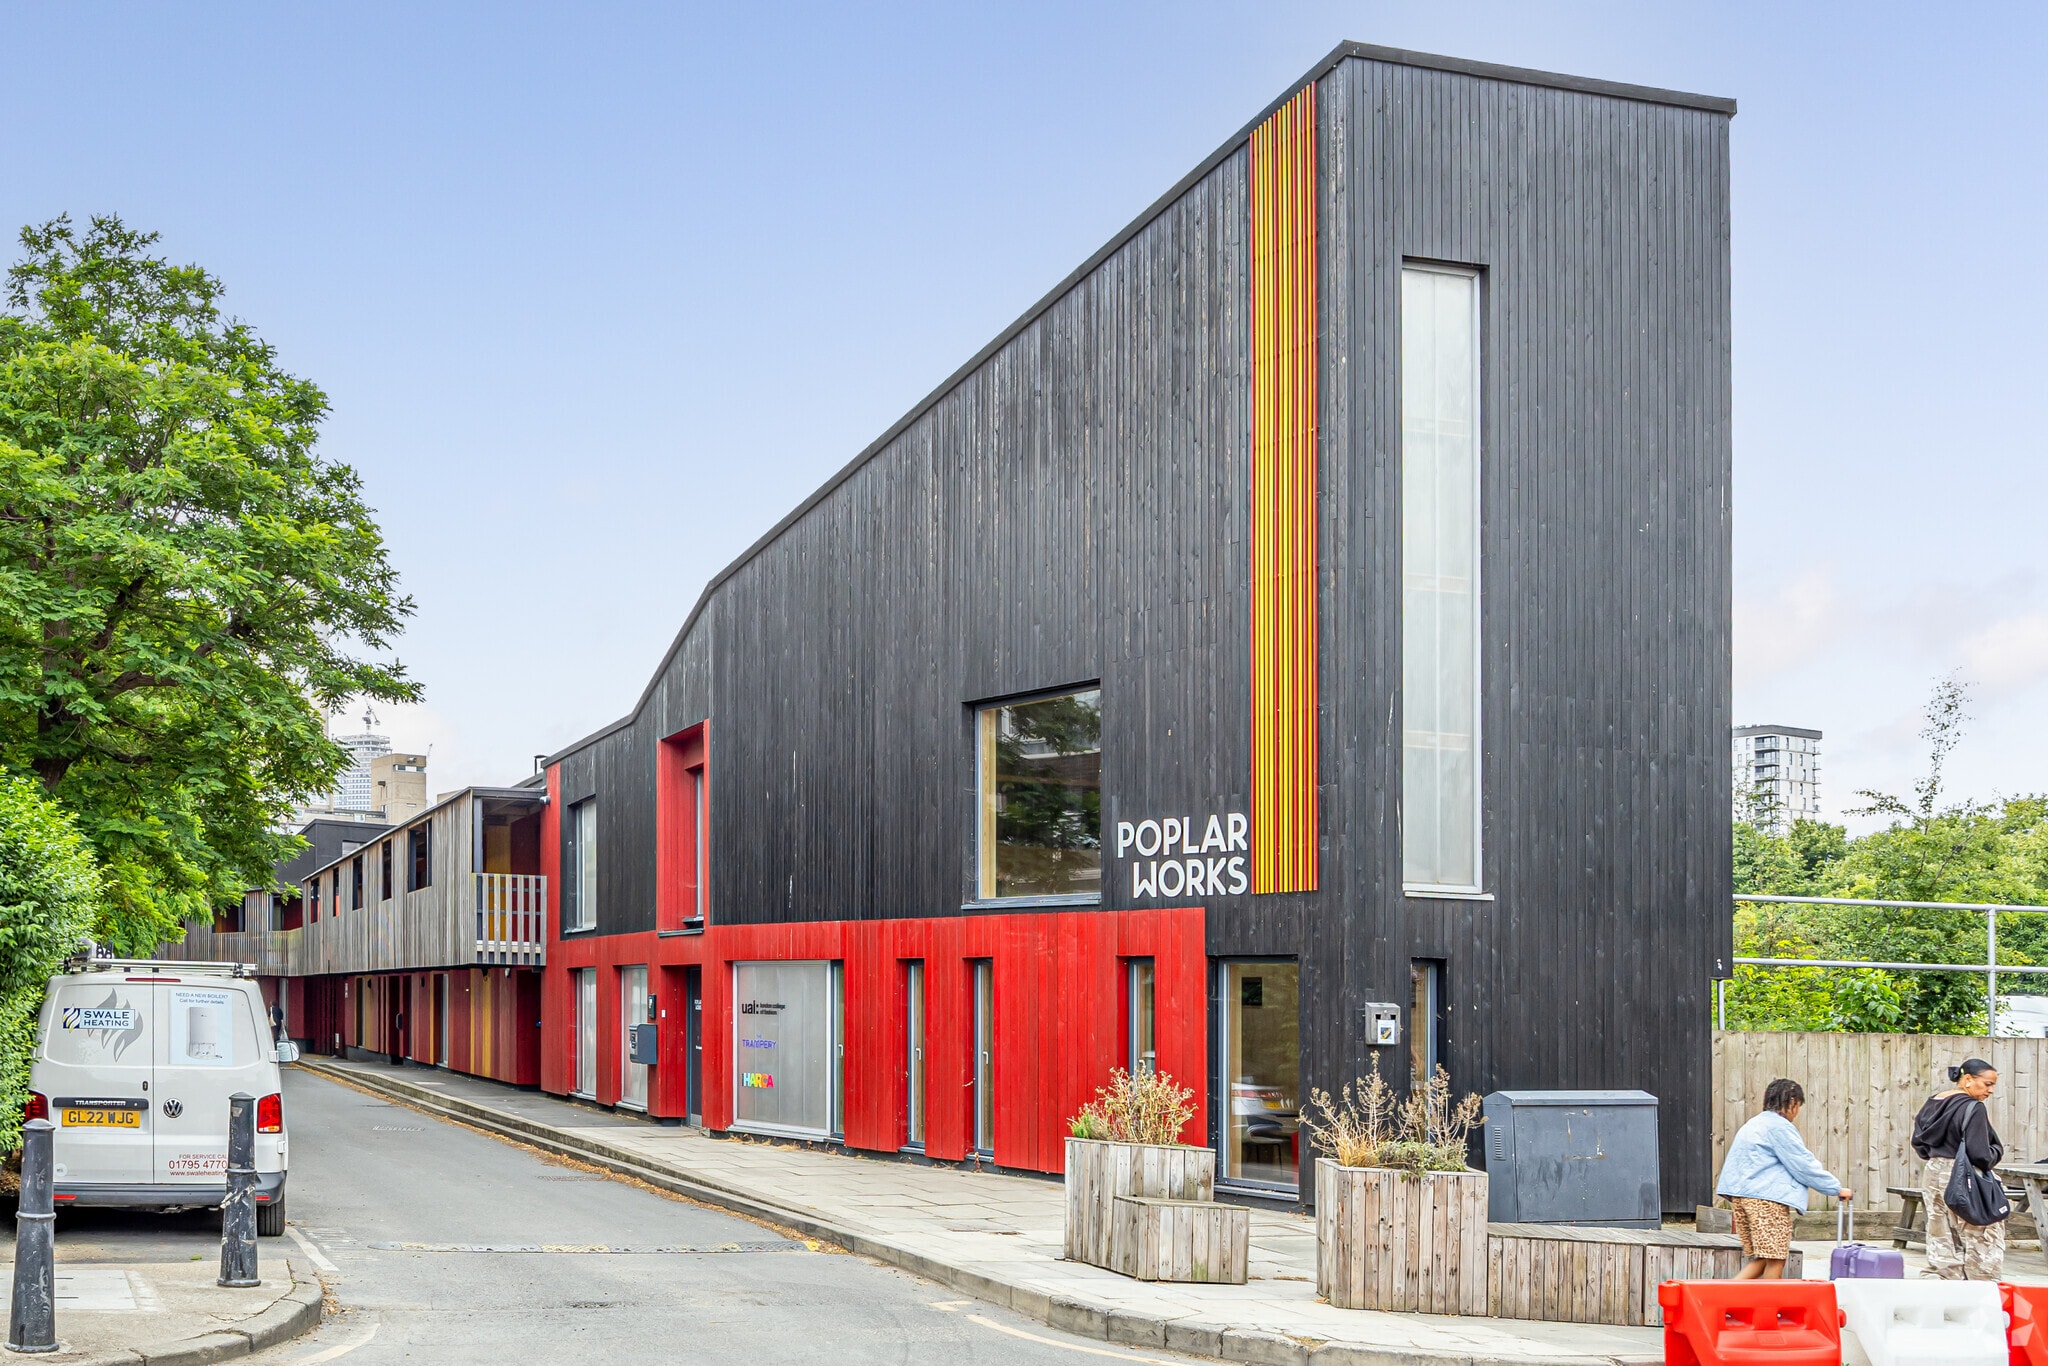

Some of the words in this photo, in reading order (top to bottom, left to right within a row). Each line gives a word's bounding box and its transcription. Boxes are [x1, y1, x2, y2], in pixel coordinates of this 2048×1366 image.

[1117, 812, 1248, 858] POPLAR
[1132, 856, 1248, 899] WORKS
[84, 1010, 130, 1020] SWALE
[84, 1019, 129, 1027] HEATING
[742, 1072, 774, 1088] HARCA
[68, 1111, 104, 1124] GL22
[107, 1112, 134, 1124] WJG
[169, 1160, 200, 1169] 01795
[203, 1160, 227, 1169] 4770
